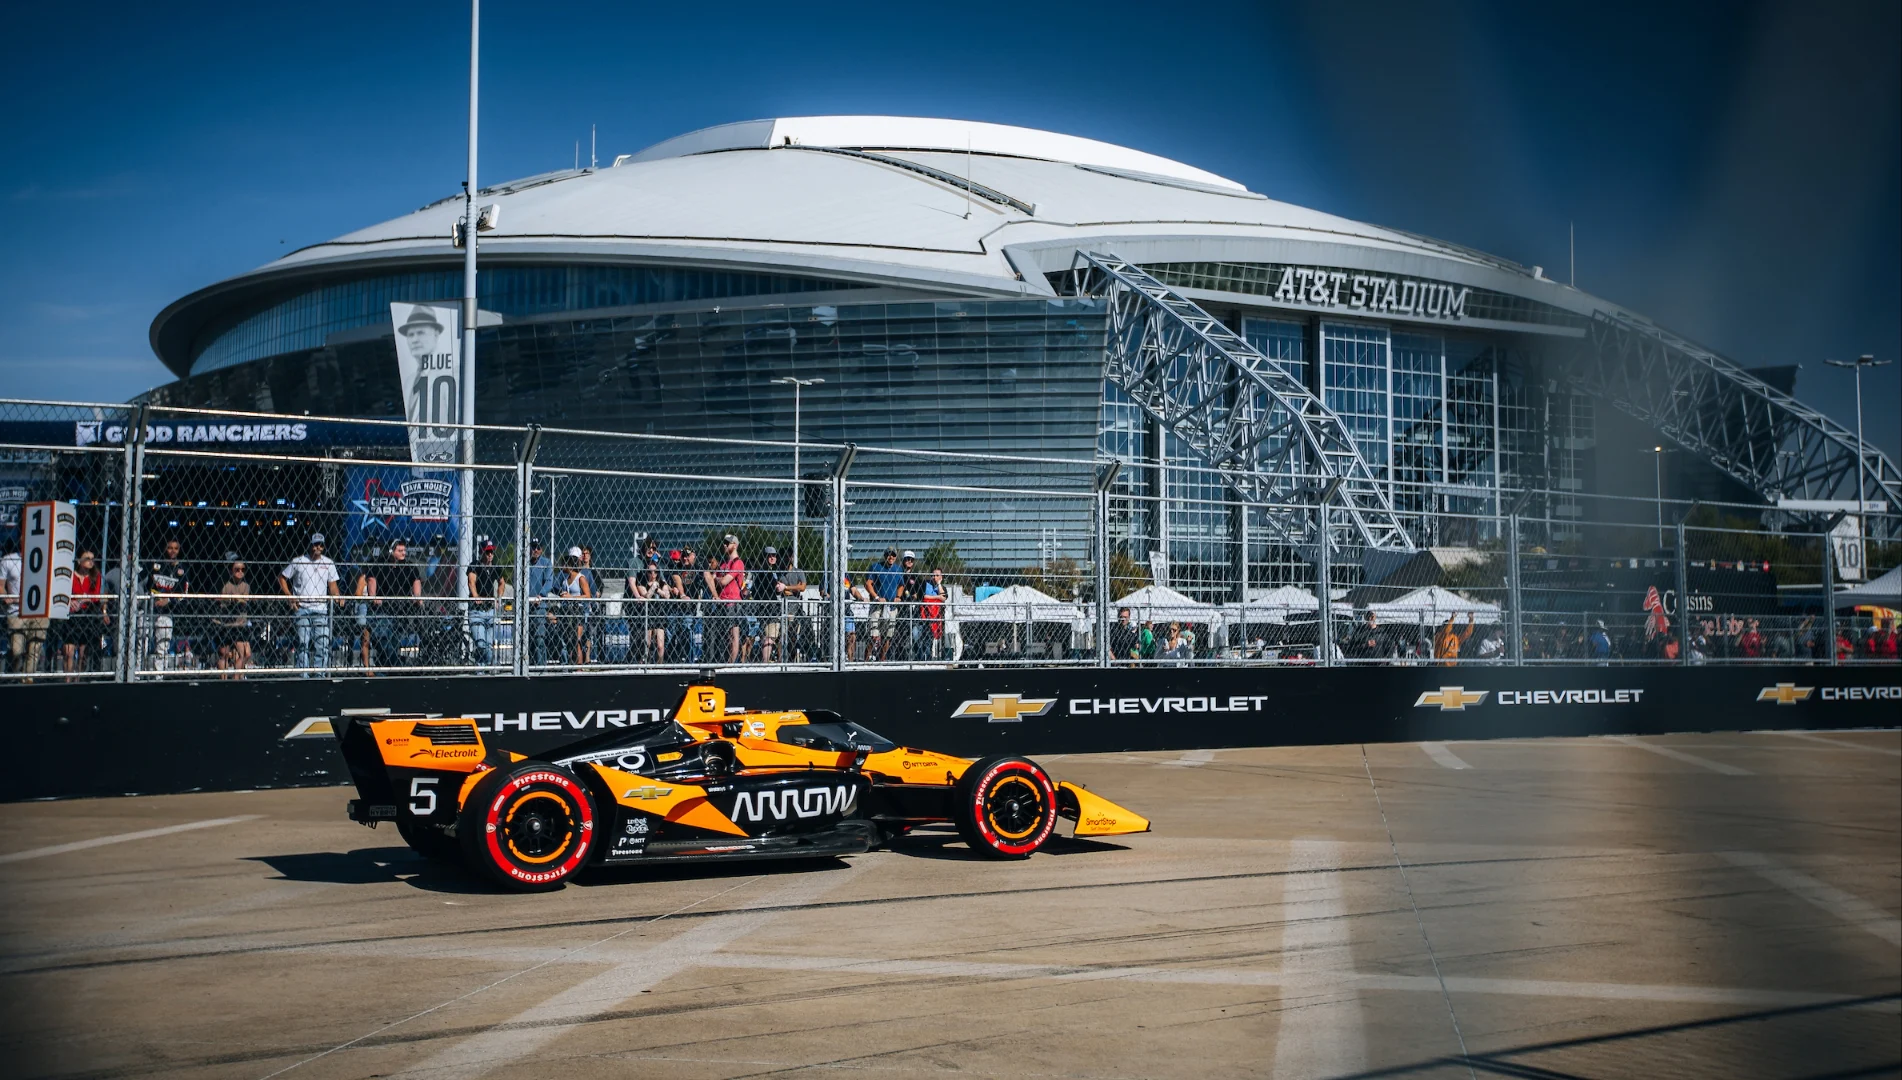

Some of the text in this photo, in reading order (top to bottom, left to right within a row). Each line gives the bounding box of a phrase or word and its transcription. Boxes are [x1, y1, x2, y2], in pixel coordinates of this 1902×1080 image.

[1275, 266, 1473, 317] AT&T STADIUM
[421, 353, 452, 370] BLUE
[413, 375, 457, 440] 10
[177, 423, 307, 442] RANCHERS
[405, 482, 448, 492] JAVA HOUSE
[371, 498, 450, 507] GRAND PRIX
[375, 507, 450, 516] ARLINGTON
[1840, 543, 1859, 568] 10
[698, 692, 716, 713] 5
[1068, 695, 1268, 716] CHEVROLET
[1497, 689, 1644, 706] CHEVROLET
[512, 773, 569, 788] Firestone
[976, 769, 998, 805] Firestone
[409, 777, 440, 816] 5
[731, 784, 857, 822] ARROW
[1034, 808, 1056, 846] Firestone
[1086, 817, 1117, 827] SmartStop
[511, 866, 568, 882] Firestone
